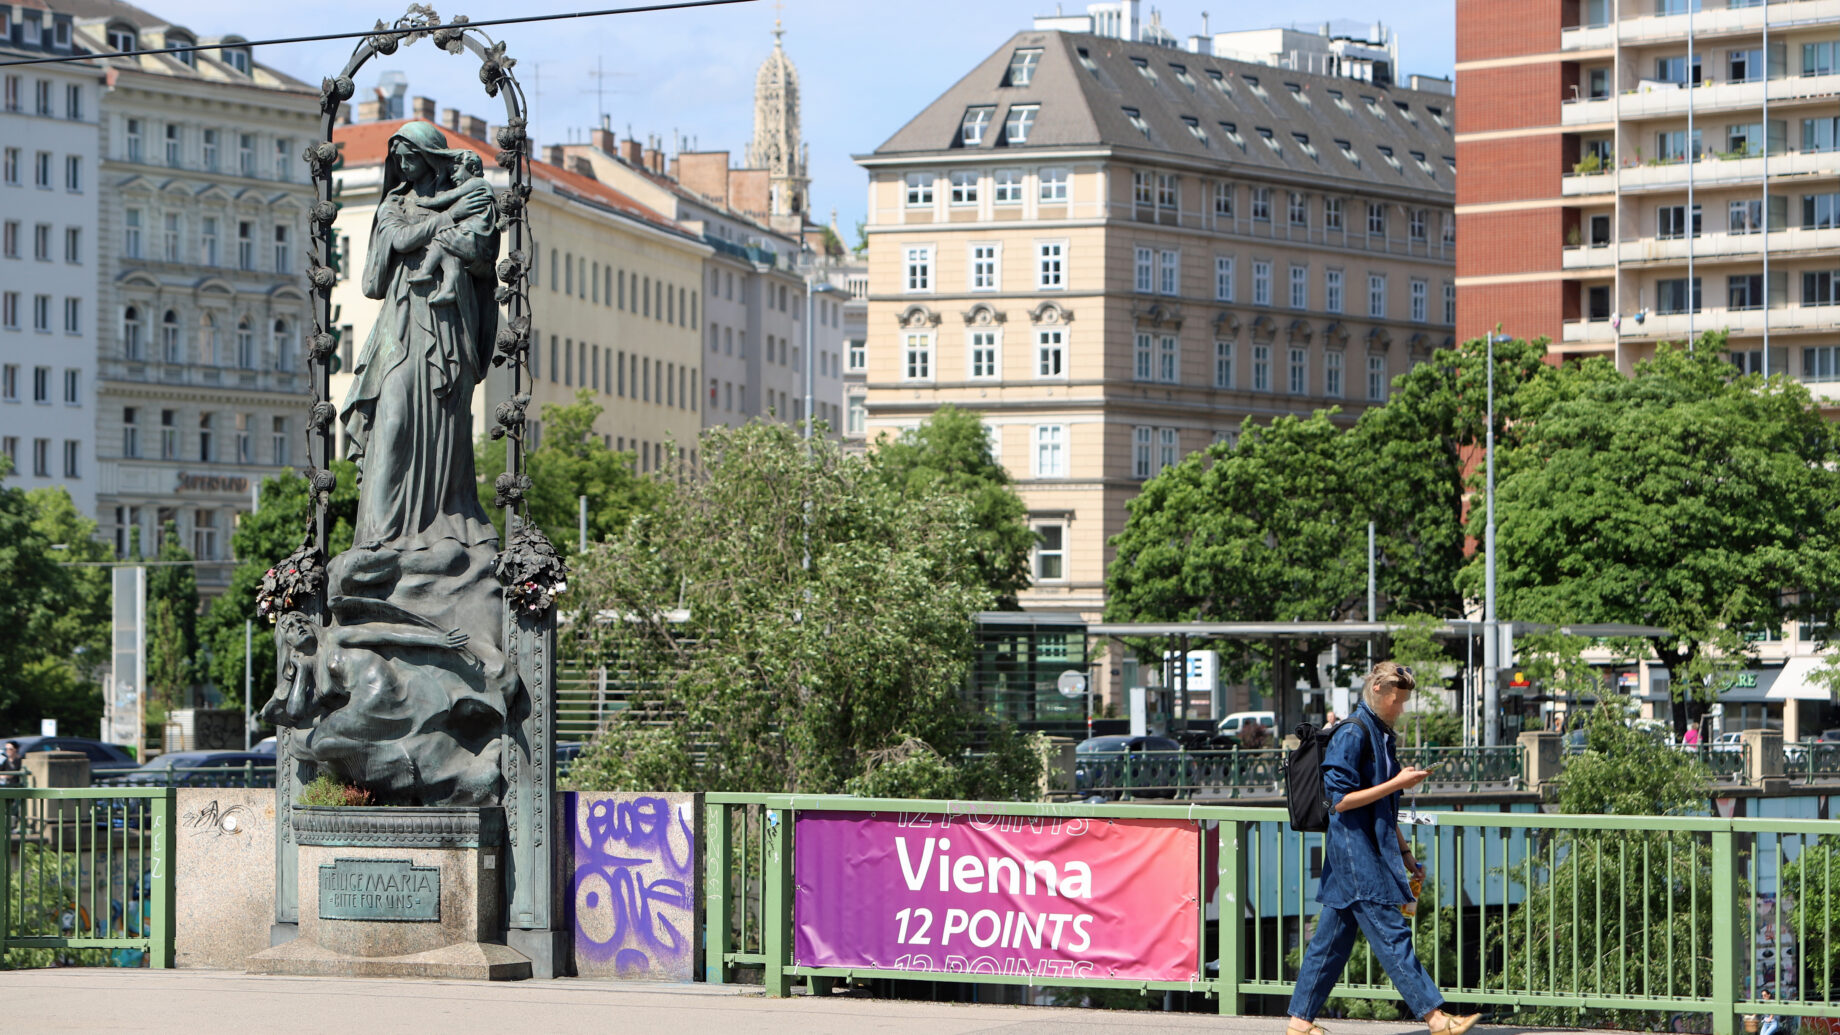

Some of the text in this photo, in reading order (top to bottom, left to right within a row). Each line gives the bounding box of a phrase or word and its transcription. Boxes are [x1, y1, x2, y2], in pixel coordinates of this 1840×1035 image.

[325, 872, 432, 893] HEILIGE MARIA
[895, 836, 1092, 898] Vienna
[386, 894, 413, 909] UNS
[895, 907, 1093, 953] 12 POINTS
